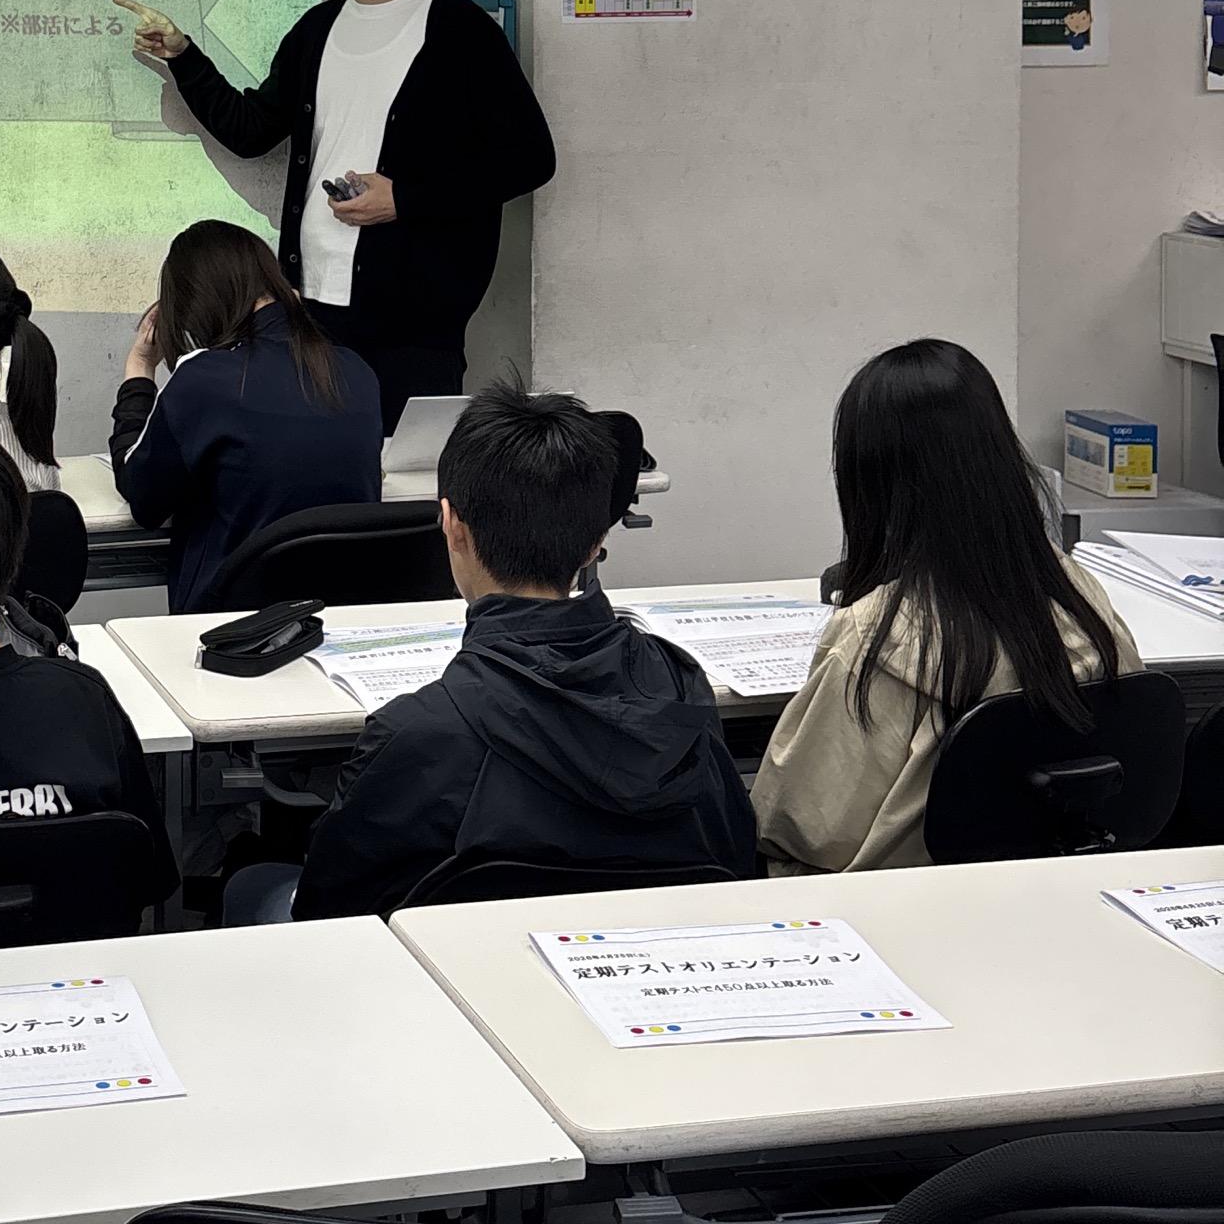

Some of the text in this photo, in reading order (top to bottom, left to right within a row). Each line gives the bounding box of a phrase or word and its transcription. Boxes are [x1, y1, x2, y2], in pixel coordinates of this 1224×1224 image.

[1, 14, 124, 36] ※部活による
[573, 953, 861, 980] 定期テストオリエンテーション
[640, 978, 834, 996] 定期テストで450点以上取る方法
